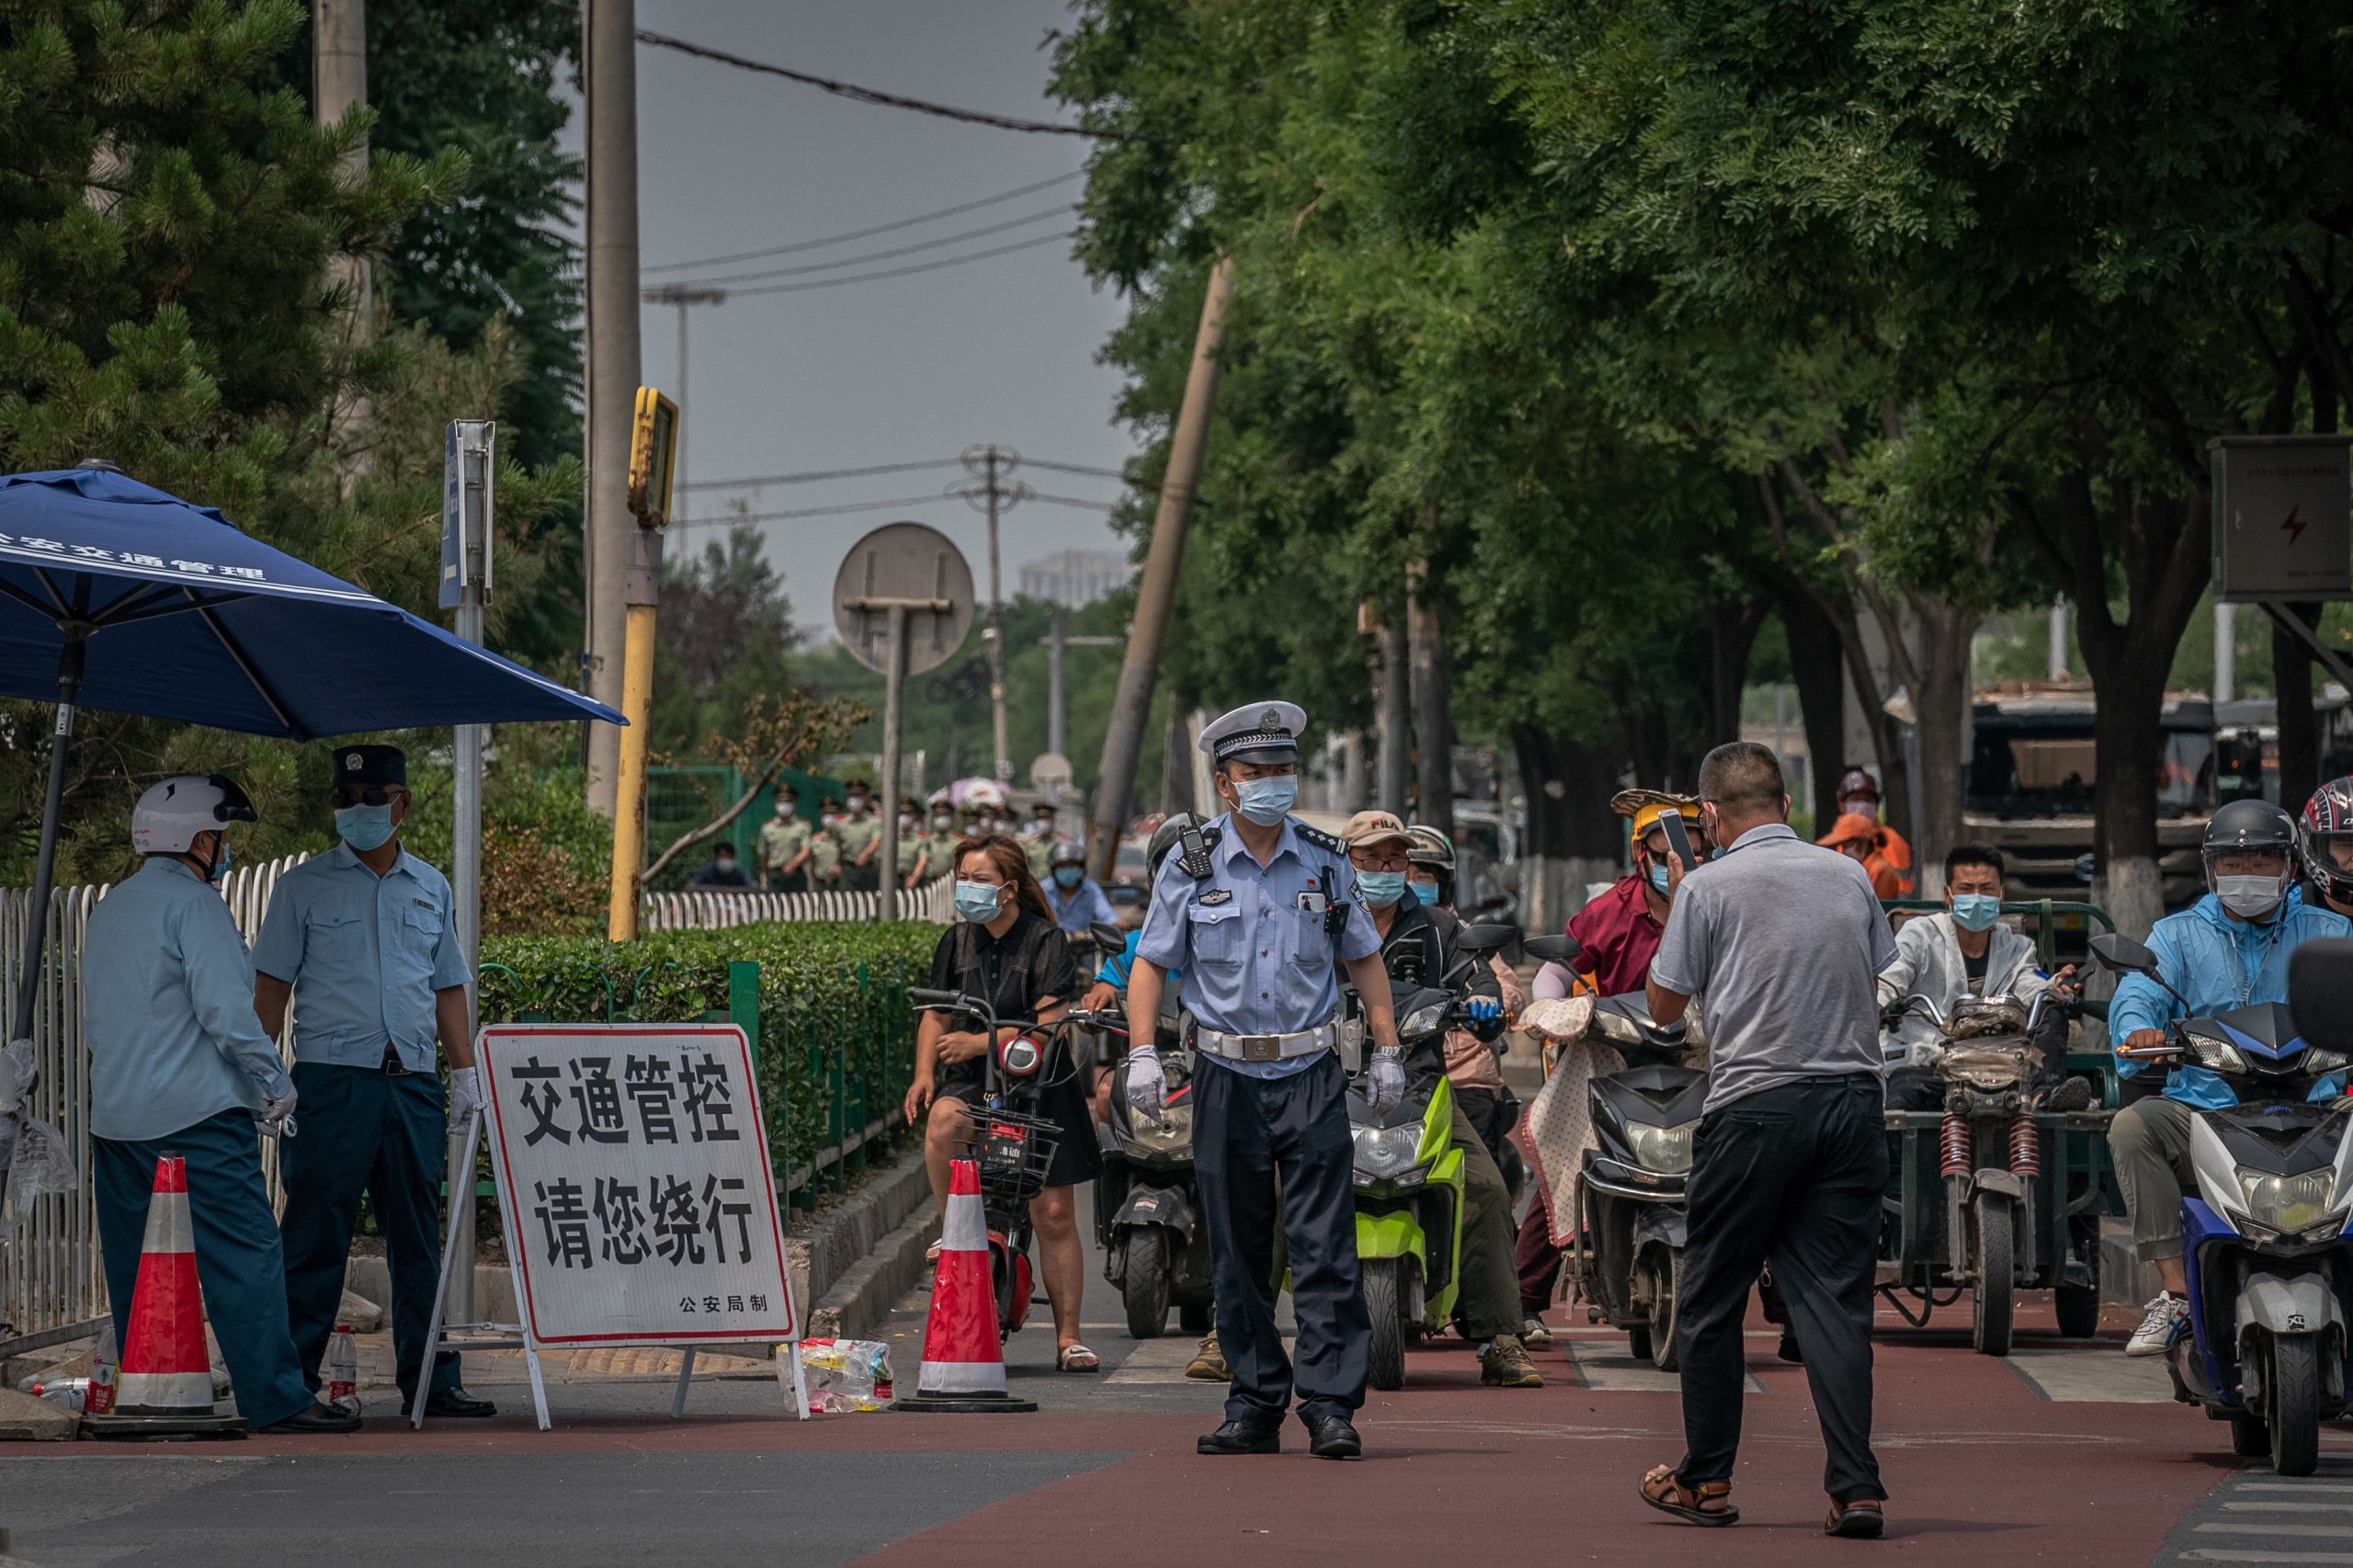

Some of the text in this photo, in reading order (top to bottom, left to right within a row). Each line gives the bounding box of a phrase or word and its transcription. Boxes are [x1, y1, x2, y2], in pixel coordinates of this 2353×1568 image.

[1370, 819, 1400, 831] FILA
[511, 1053, 740, 1147] 交通管控
[534, 1173, 752, 1269] 请您绕行
[679, 1294, 768, 1313] 公安局制
